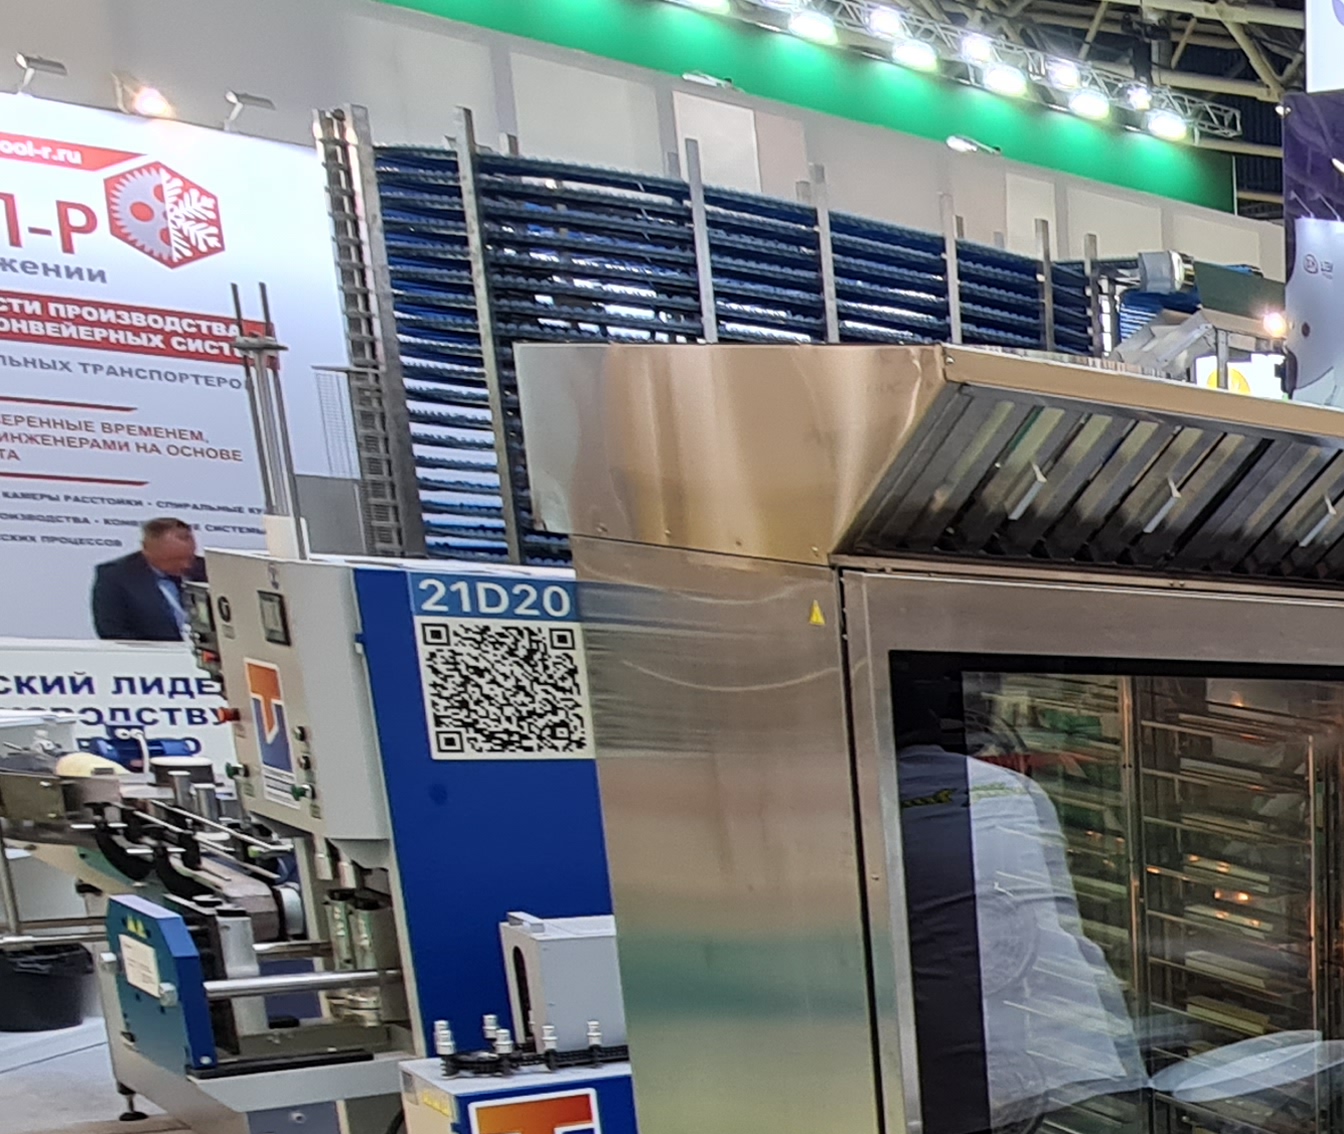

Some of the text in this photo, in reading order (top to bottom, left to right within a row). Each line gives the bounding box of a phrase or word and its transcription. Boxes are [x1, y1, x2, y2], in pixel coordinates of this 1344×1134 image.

[47, 302, 240, 338] ПРОИЗВОДСТВА
[170, 336, 256, 359] СИСТ
[78, 361, 242, 390] ТРАНСПОРТЕРО
[101, 421, 209, 443] ВРЕМЕНЕМ,
[135, 442, 162, 455] НА
[166, 444, 243, 462] ОСНОВЕ
[418, 578, 571, 618] 21D20
[112, 676, 223, 699] ЛИДЕ
